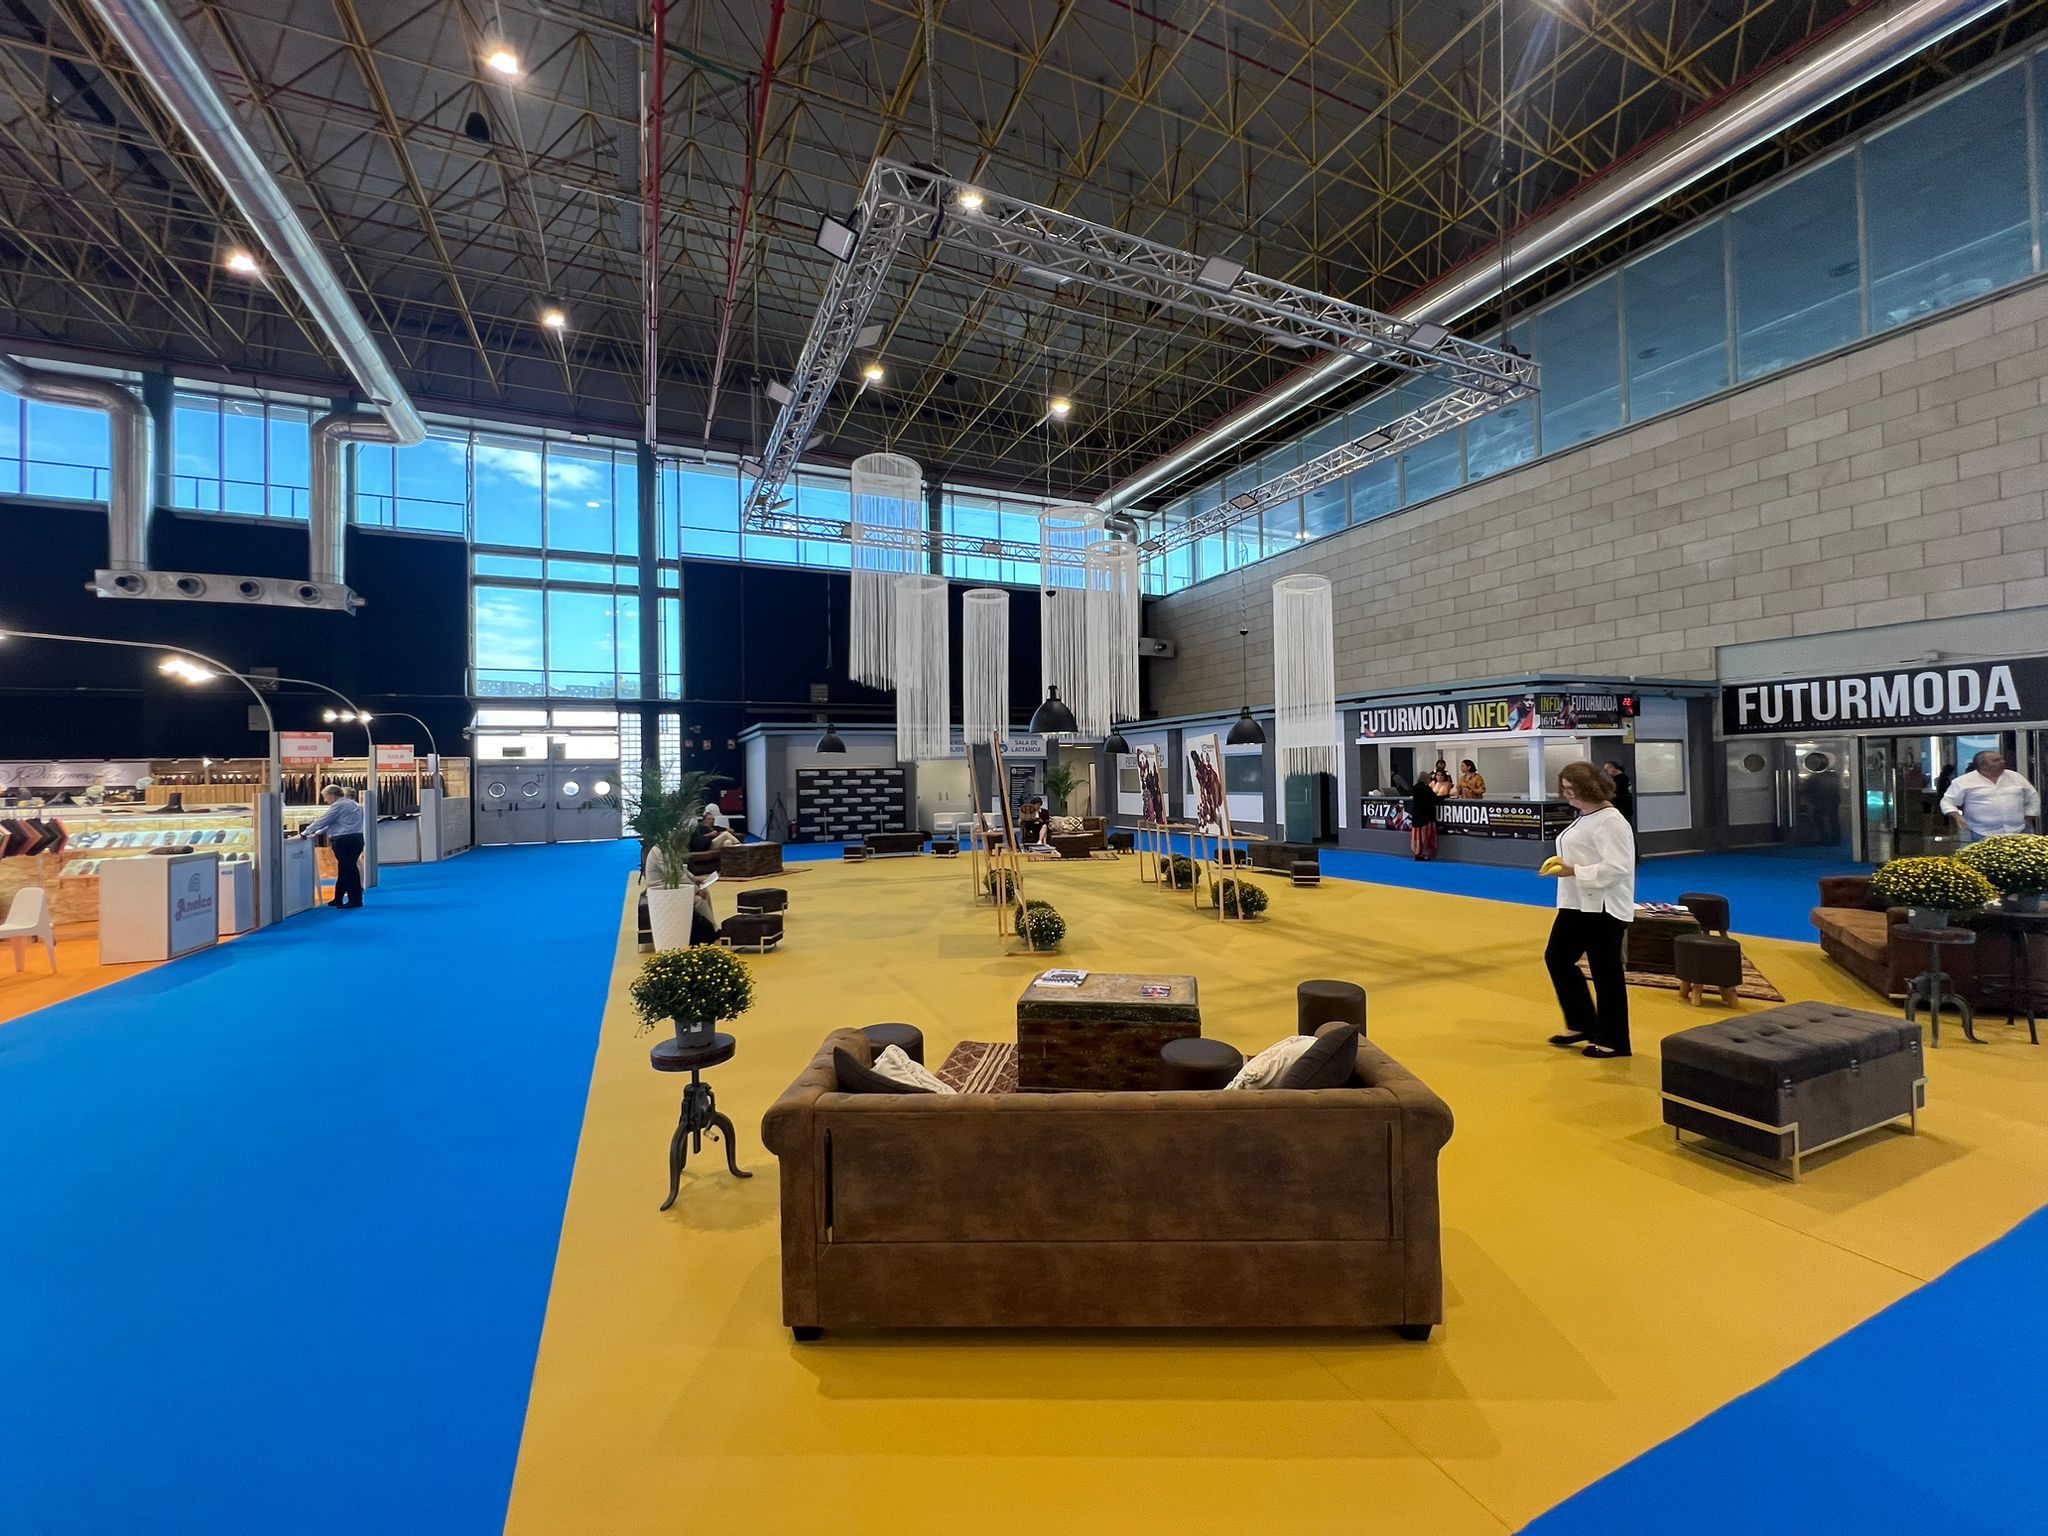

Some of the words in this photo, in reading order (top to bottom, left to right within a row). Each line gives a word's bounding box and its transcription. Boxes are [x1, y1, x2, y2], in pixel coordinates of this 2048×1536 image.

[1541, 696, 1561, 711] INFO
[1571, 695, 1619, 712] FUTURMODA
[1738, 665, 2022, 726] FUTURMODA
[1359, 703, 1459, 734] FUTURMODA
[1468, 701, 1509, 728] INFO
[1541, 716, 1558, 726] 16/17
[536, 774, 545, 783] 37
[1362, 803, 1391, 818] 16/17
[1435, 804, 1489, 825] URMODA
